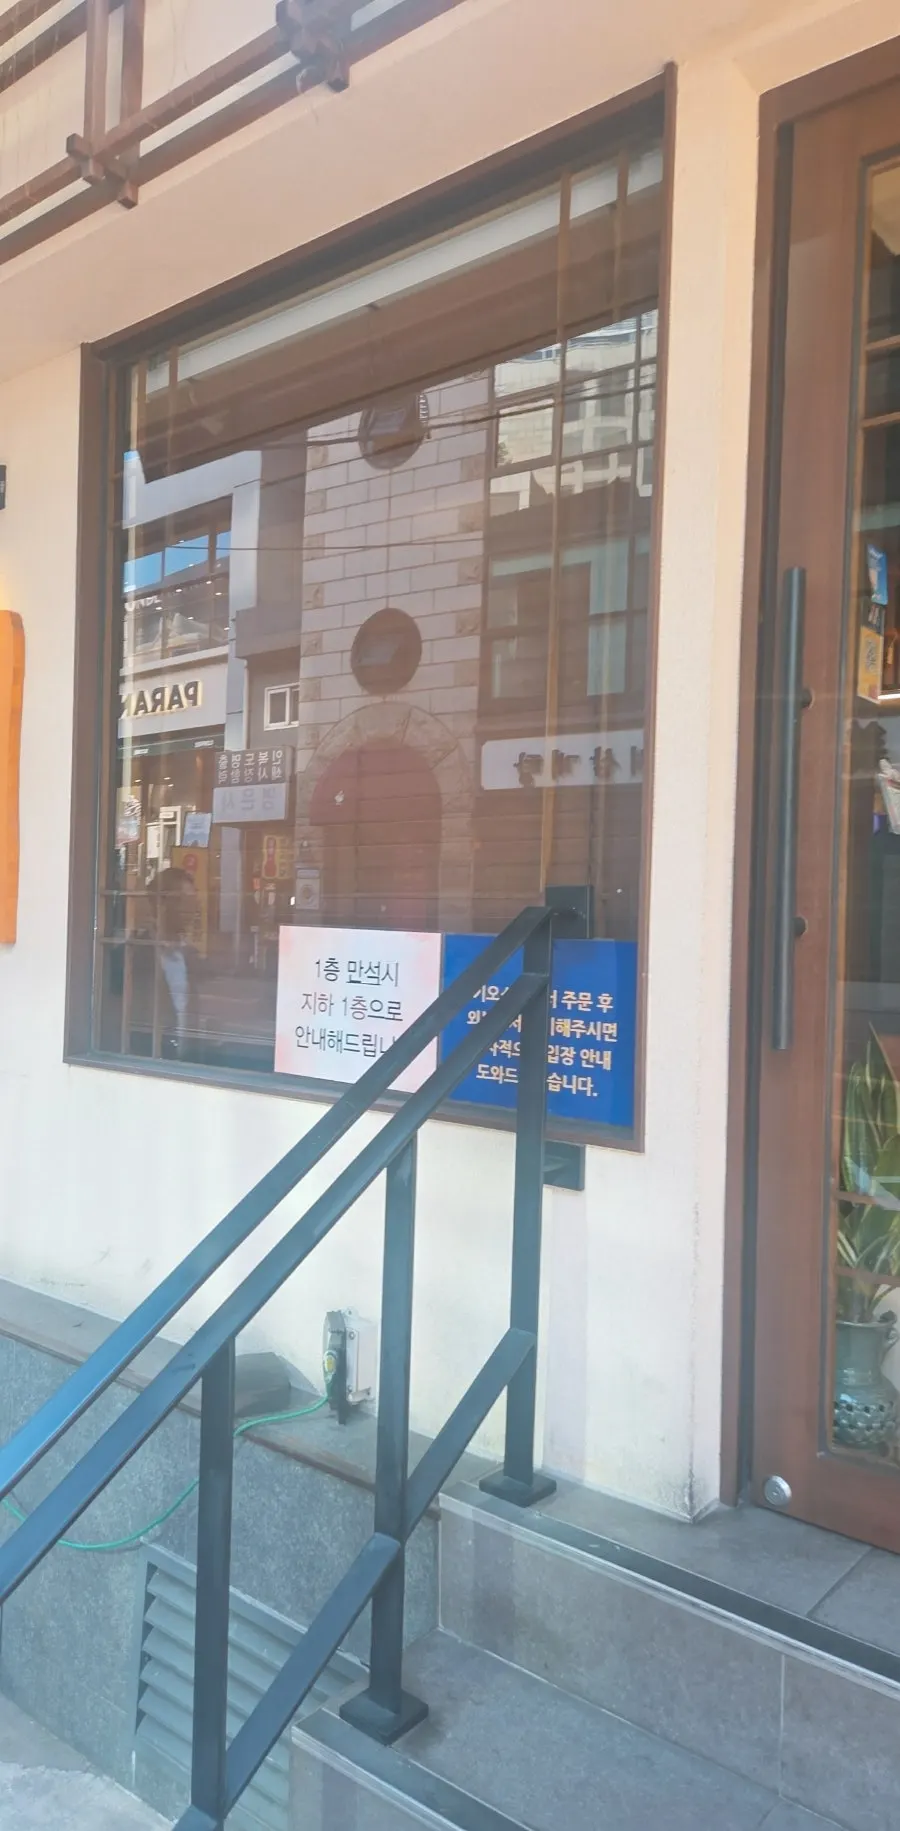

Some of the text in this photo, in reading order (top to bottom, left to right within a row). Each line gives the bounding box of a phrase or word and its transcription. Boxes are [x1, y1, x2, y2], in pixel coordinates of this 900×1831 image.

[315, 957, 399, 987] 1층 만석시
[301, 992, 403, 1021] 지하 1층으로
[561, 990, 593, 1012] 주문
[596, 993, 614, 1013] 후
[547, 1044, 576, 1066] 입장
[580, 1048, 612, 1070] 안내
